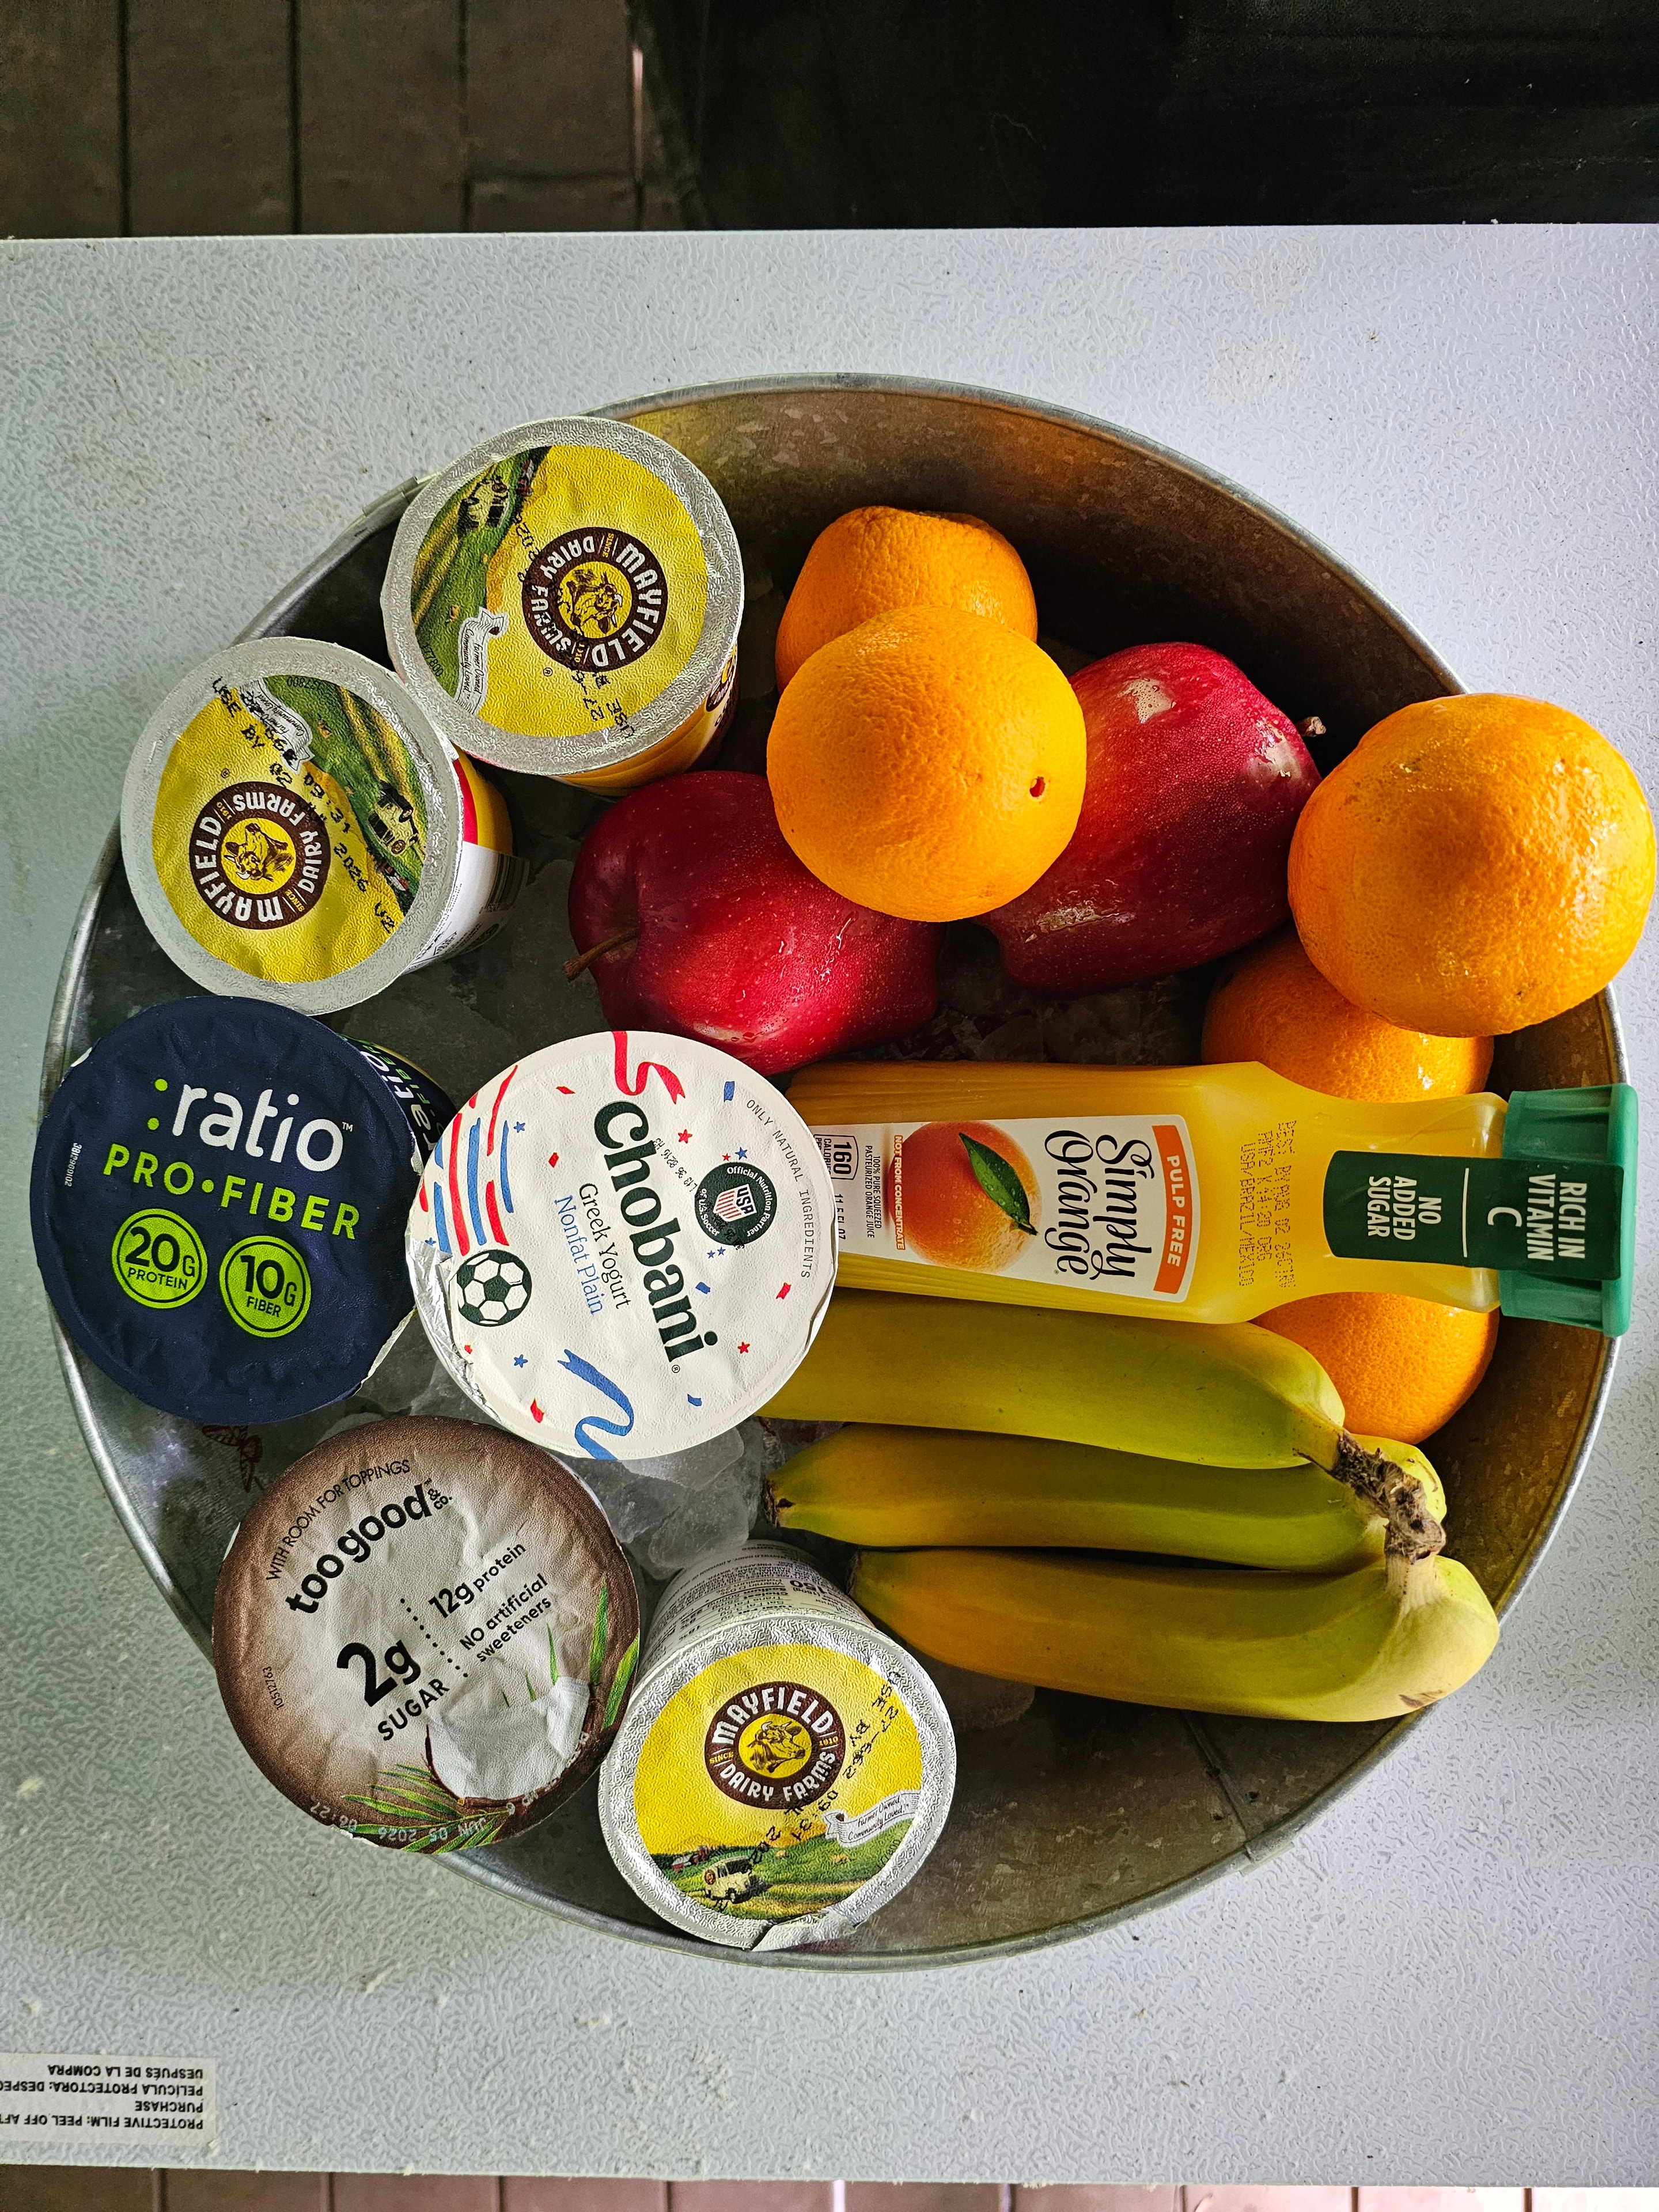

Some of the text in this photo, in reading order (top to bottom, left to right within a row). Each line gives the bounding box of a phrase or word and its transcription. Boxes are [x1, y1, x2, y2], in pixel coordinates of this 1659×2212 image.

[540, 536, 595, 579] DAIRY
[603, 533, 614, 558] SINCE
[531, 585, 571, 652] FARMS
[592, 543, 662, 667] MAYFIELD
[461, 629, 474, 669] Community
[474, 643, 483, 668] Farmer
[272, 705, 305, 736] Community
[212, 676, 242, 718] USE
[240, 723, 265, 749] BY
[334, 842, 369, 892] 2026
[232, 790, 306, 826] FARMS
[195, 815, 284, 922] MAYFIELD
[298, 830, 322, 893] DAIRY
[286, 889, 305, 912] SINCE
[833, 1141, 852, 1175] 160
[894, 1135, 903, 1157] NOT
[727, 1166, 772, 1237] Official Nutrition Partner
[736, 1187, 754, 1214] USA
[747, 1100, 815, 1279] ONLY NATURAL INGREDIENTS
[873, 1176, 881, 1194] PURE
[1044, 1130, 1098, 1275] Orange
[700, 1213, 720, 1236] Soccer
[873, 1196, 881, 1229] SQUEEZED
[895, 1184, 906, 1250] CONCENTRATE
[1090, 1134, 1153, 1281] Simply
[1165, 1156, 1185, 1267] PULP FREE
[1367, 1176, 1392, 1237] SUGAR
[1393, 1176, 1417, 1241] ADDED
[1418, 1196, 1441, 1225] NO
[1487, 1207, 1522, 1227] C
[1527, 1173, 1556, 1261] VITAMIN
[1557, 1181, 1588, 1259] RICH IN
[579, 1183, 631, 1310] Greek Yogurt
[594, 1100, 718, 1363] Chobani
[866, 1220, 874, 1238] JUICE
[554, 1195, 602, 1316] Nonfat Plain
[128, 1268, 188, 1290] PROTEIN
[246, 1296, 281, 1317] FIBER
[266, 1459, 410, 1581] WITH ROOM FOR TOPPINGS
[286, 1483, 431, 1613] too good
[428, 1542, 526, 1618] 12g protein
[789, 1580, 829, 1594] 150
[459, 1573, 548, 1652] NO artificial
[476, 1596, 552, 1662] sweeteners
[263, 1666, 284, 1710] 10512763
[336, 1639, 421, 1707] 2g
[378, 1678, 449, 1741] SUGAR
[711, 1687, 834, 1745] MAYFIELD
[709, 1751, 734, 1764] SINCE
[819, 1736, 839, 1746] 1910
[719, 1751, 835, 1802] DAIRY FARMS
[848, 1815, 884, 1841] Community
[857, 1811, 879, 1828] Farmer
[48, 2064, 203, 2081] DESPUÉS DE LA COMPRA
[49, 2082, 138, 2094] PROTECTORA:
[142, 2084, 203, 2099] PELÍCULA
[24, 2114, 47, 2126] OFF
[52, 2115, 83, 2126] PEEL
[87, 2116, 120, 2127] FILM:
[124, 2117, 203, 2130] PROTECTIVE
[135, 2100, 204, 2113] PURCHASE
